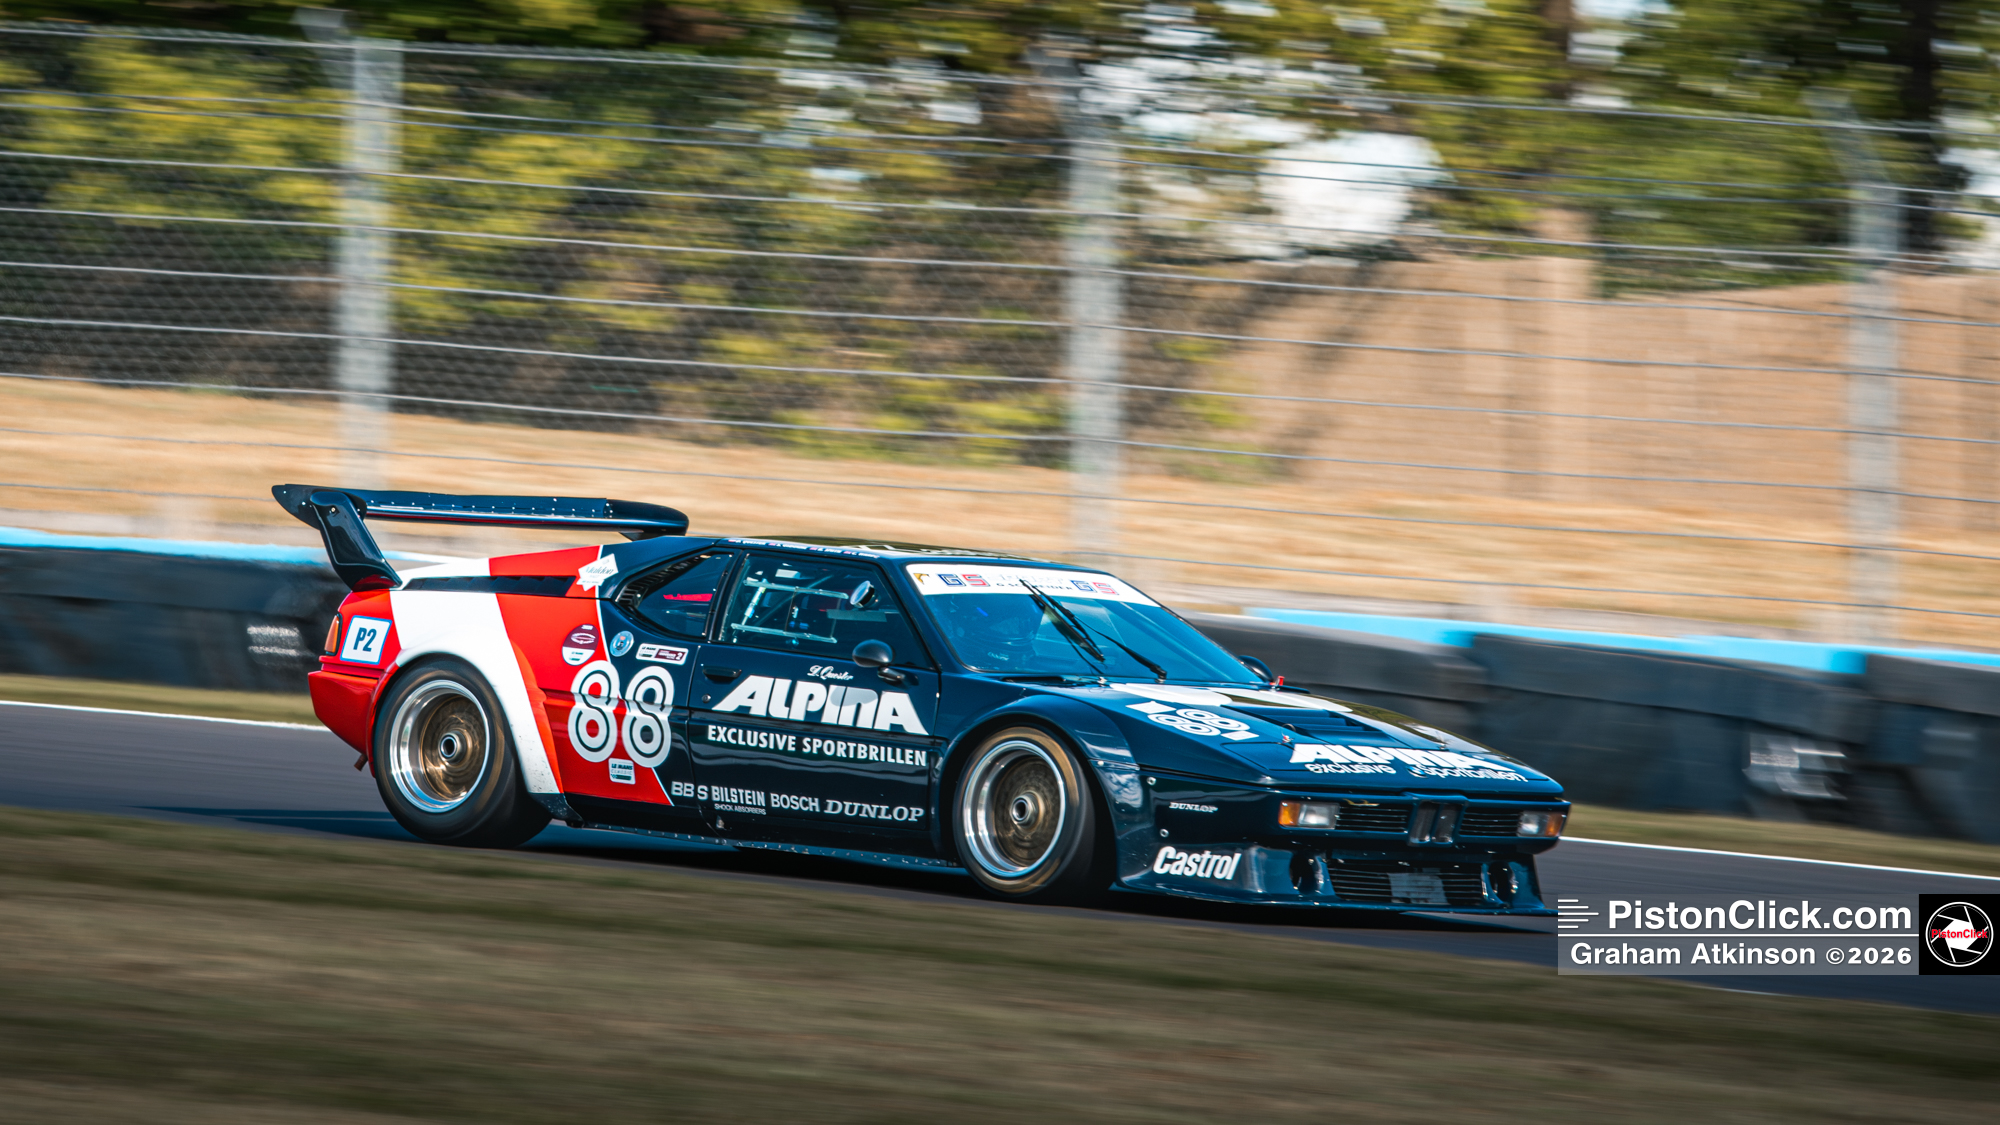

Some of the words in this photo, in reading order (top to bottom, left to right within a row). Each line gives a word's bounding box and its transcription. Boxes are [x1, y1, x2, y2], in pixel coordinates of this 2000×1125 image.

[353, 627, 377, 652] P2
[567, 660, 675, 768] 88
[707, 725, 796, 752] EXCLUSIVE
[802, 737, 927, 767] SPORTBRILLEN
[1304, 763, 1396, 774] exclusive
[711, 785, 766, 807] BILSTEIN
[770, 793, 820, 812] BOSCH
[714, 803, 734, 811] SHOCK
[735, 806, 767, 815] ABSORBERS
[824, 799, 924, 822] DUNLOP
[1169, 802, 1219, 813] DUNLOP
[1153, 846, 1242, 880] Castrol
